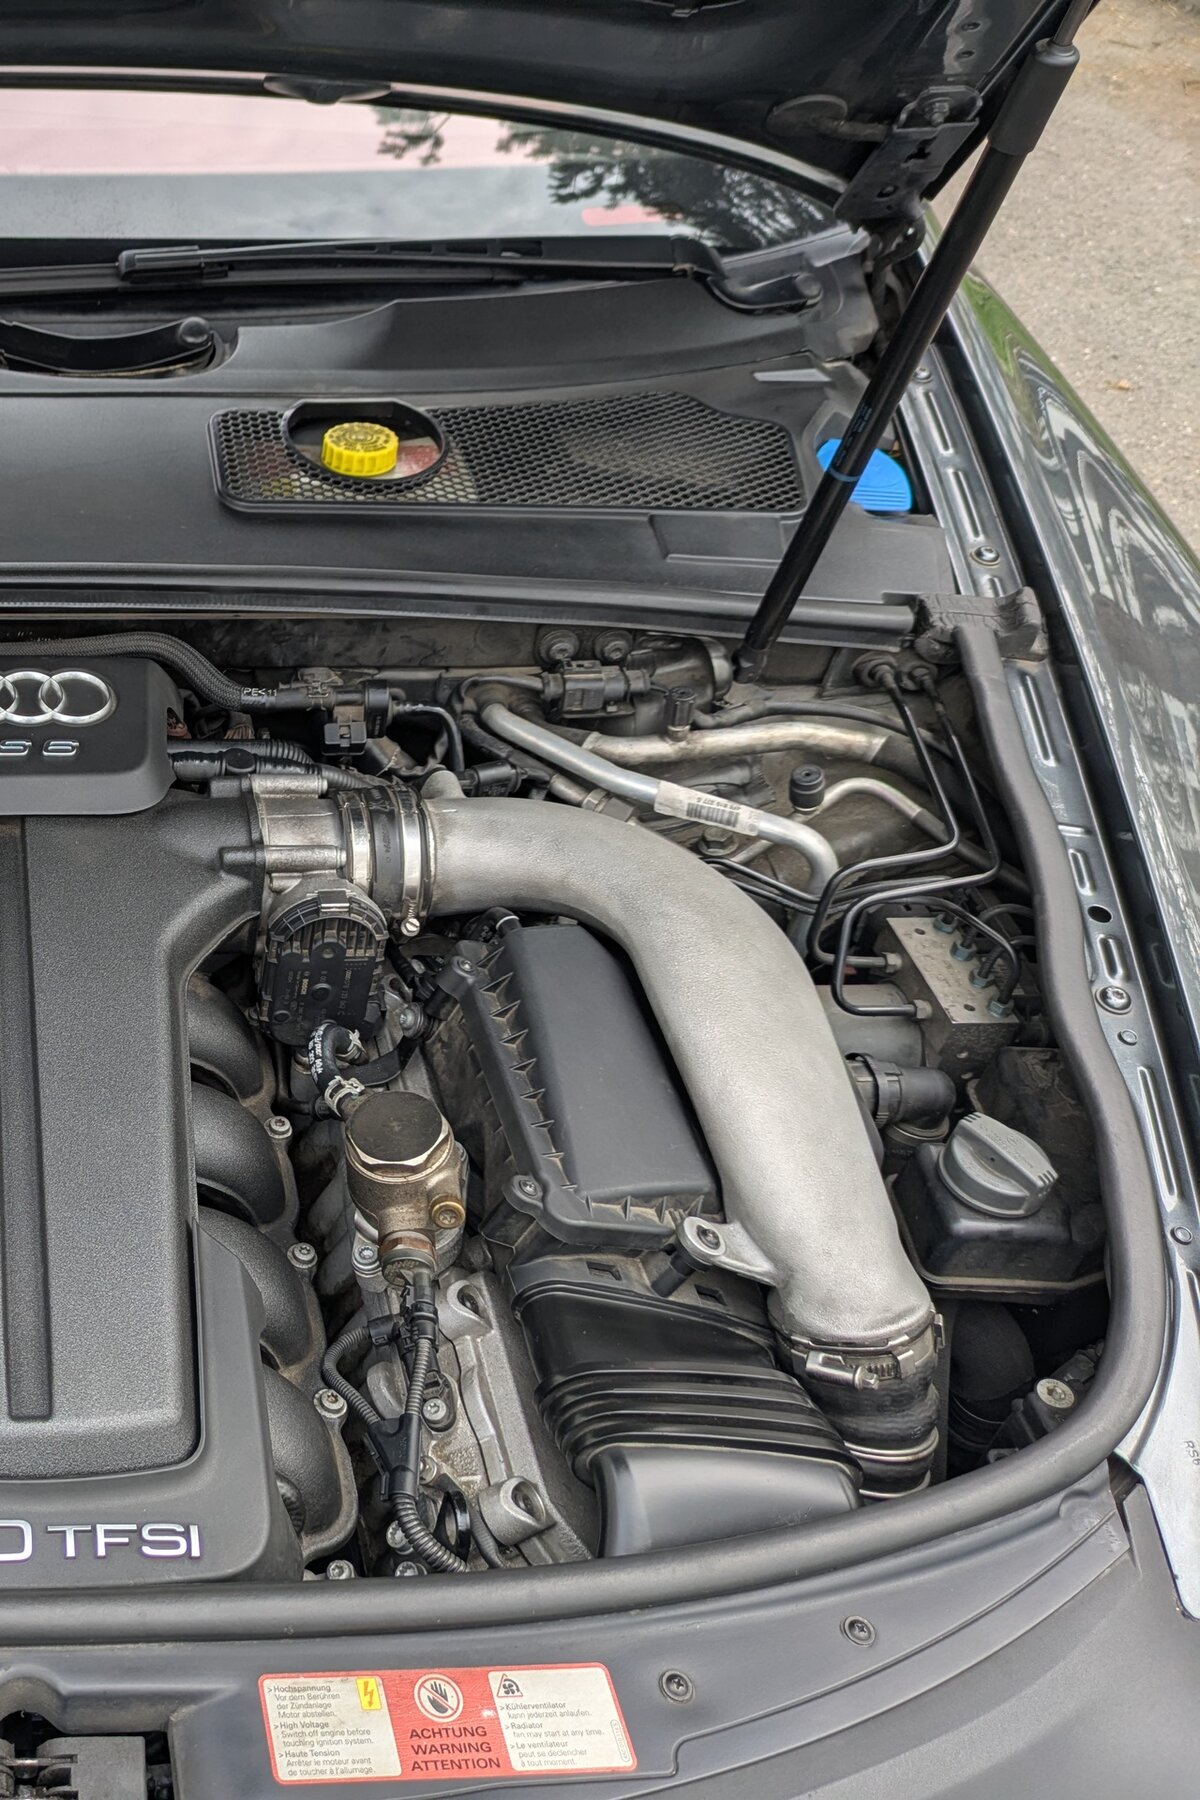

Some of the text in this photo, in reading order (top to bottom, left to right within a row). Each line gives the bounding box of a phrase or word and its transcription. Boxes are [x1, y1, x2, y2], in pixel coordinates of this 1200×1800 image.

[47, 1523, 201, 1558] TFSI
[273, 1685, 331, 1693] Hochspannung
[307, 1692, 340, 1700] Berühren
[290, 1702, 332, 1710] Zündanlage
[505, 1702, 566, 1710] Kühlerventilator
[507, 1711, 525, 1719] kann
[527, 1710, 558, 1720] jederzeit
[280, 1721, 329, 1730] High Voltage
[510, 1721, 543, 1729] Radiator
[281, 1730, 307, 1738] Switch
[320, 1729, 345, 1738] engine
[346, 1728, 371, 1736] before
[409, 1726, 487, 1739] ACHTUNG
[562, 1729, 569, 1737] at
[282, 1738, 374, 1748] touching ignition system.
[527, 1740, 568, 1748] ventilateur
[411, 1741, 492, 1755] WARNING
[284, 1749, 340, 1758] Haute Tension
[351, 1757, 372, 1765] avant
[411, 1757, 501, 1771] ATTENTION
[299, 1768, 328, 1776] toucher
